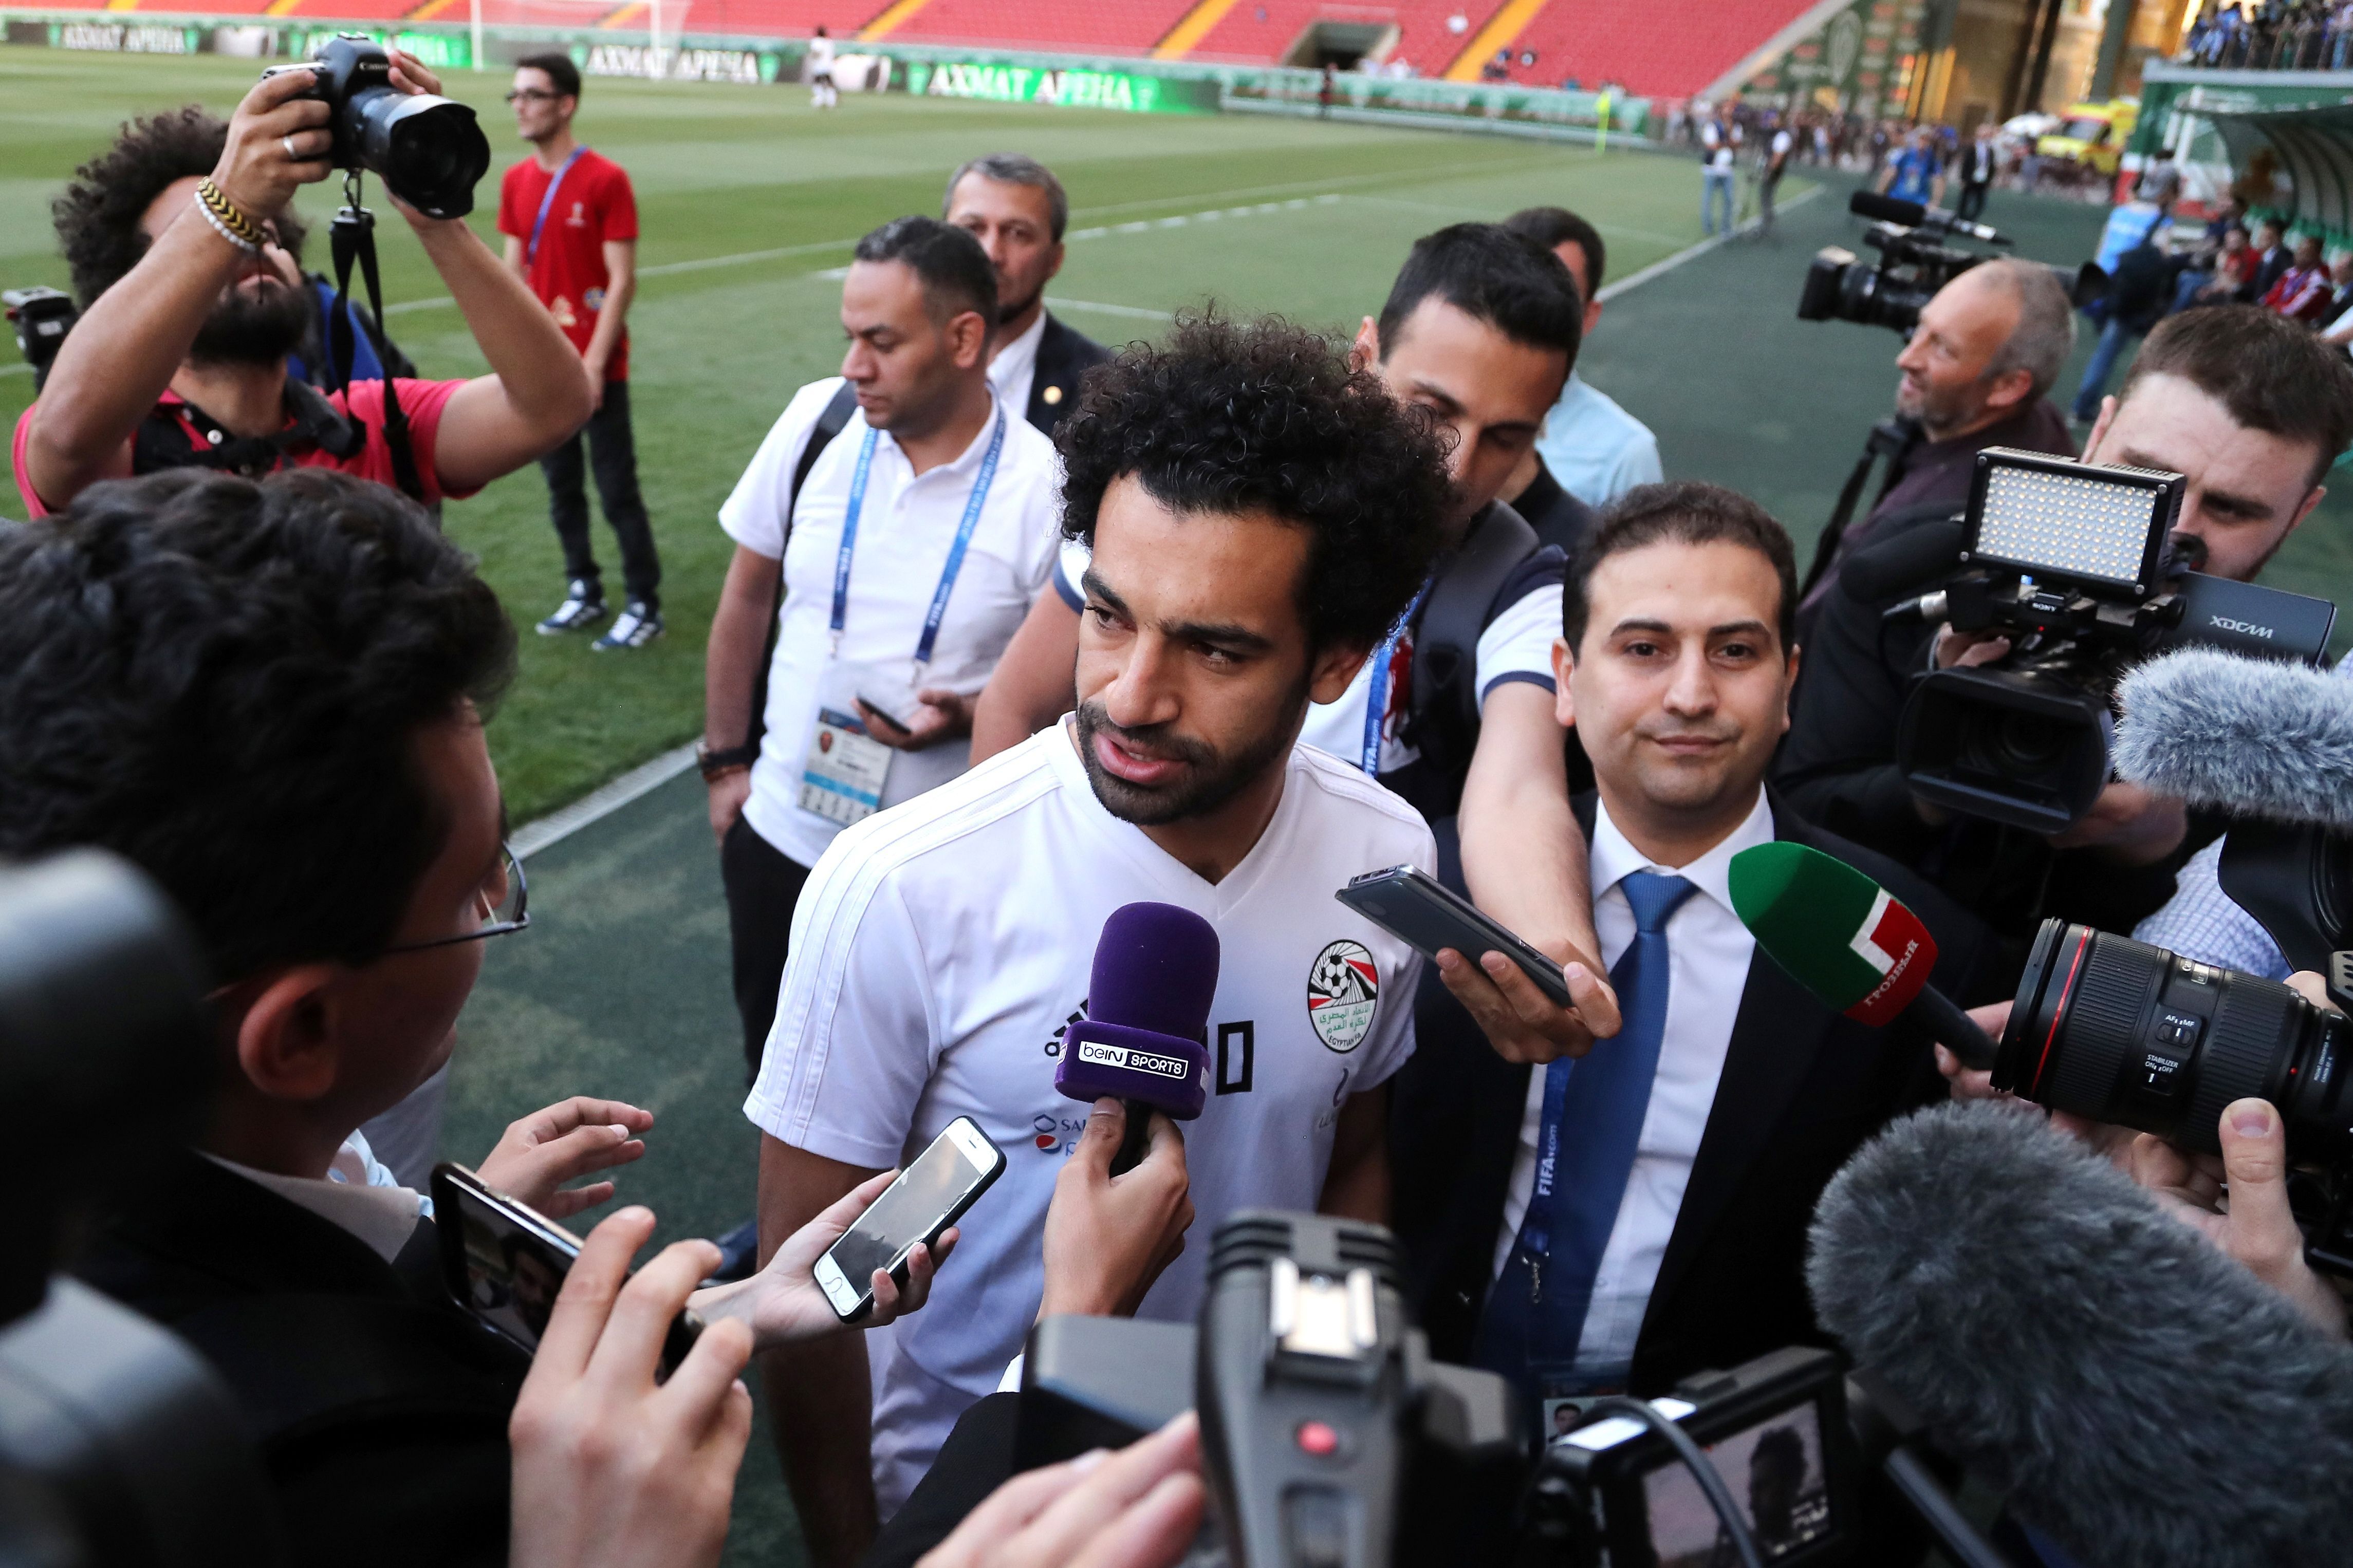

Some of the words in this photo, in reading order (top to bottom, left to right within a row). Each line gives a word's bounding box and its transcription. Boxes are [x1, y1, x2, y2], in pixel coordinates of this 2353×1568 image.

[2032, 602, 2057, 612] SONY
[2210, 615, 2273, 639] XDCAM
[1864, 939, 1919, 1007] ГРОЗНЫЙ
[2183, 1019, 2195, 1027] MF
[1328, 1035, 1355, 1047] EGYPTIAN
[1355, 1033, 1362, 1041] FA
[1131, 1054, 1182, 1074] SPORTS
[2147, 1054, 2179, 1068] STABILIZER
